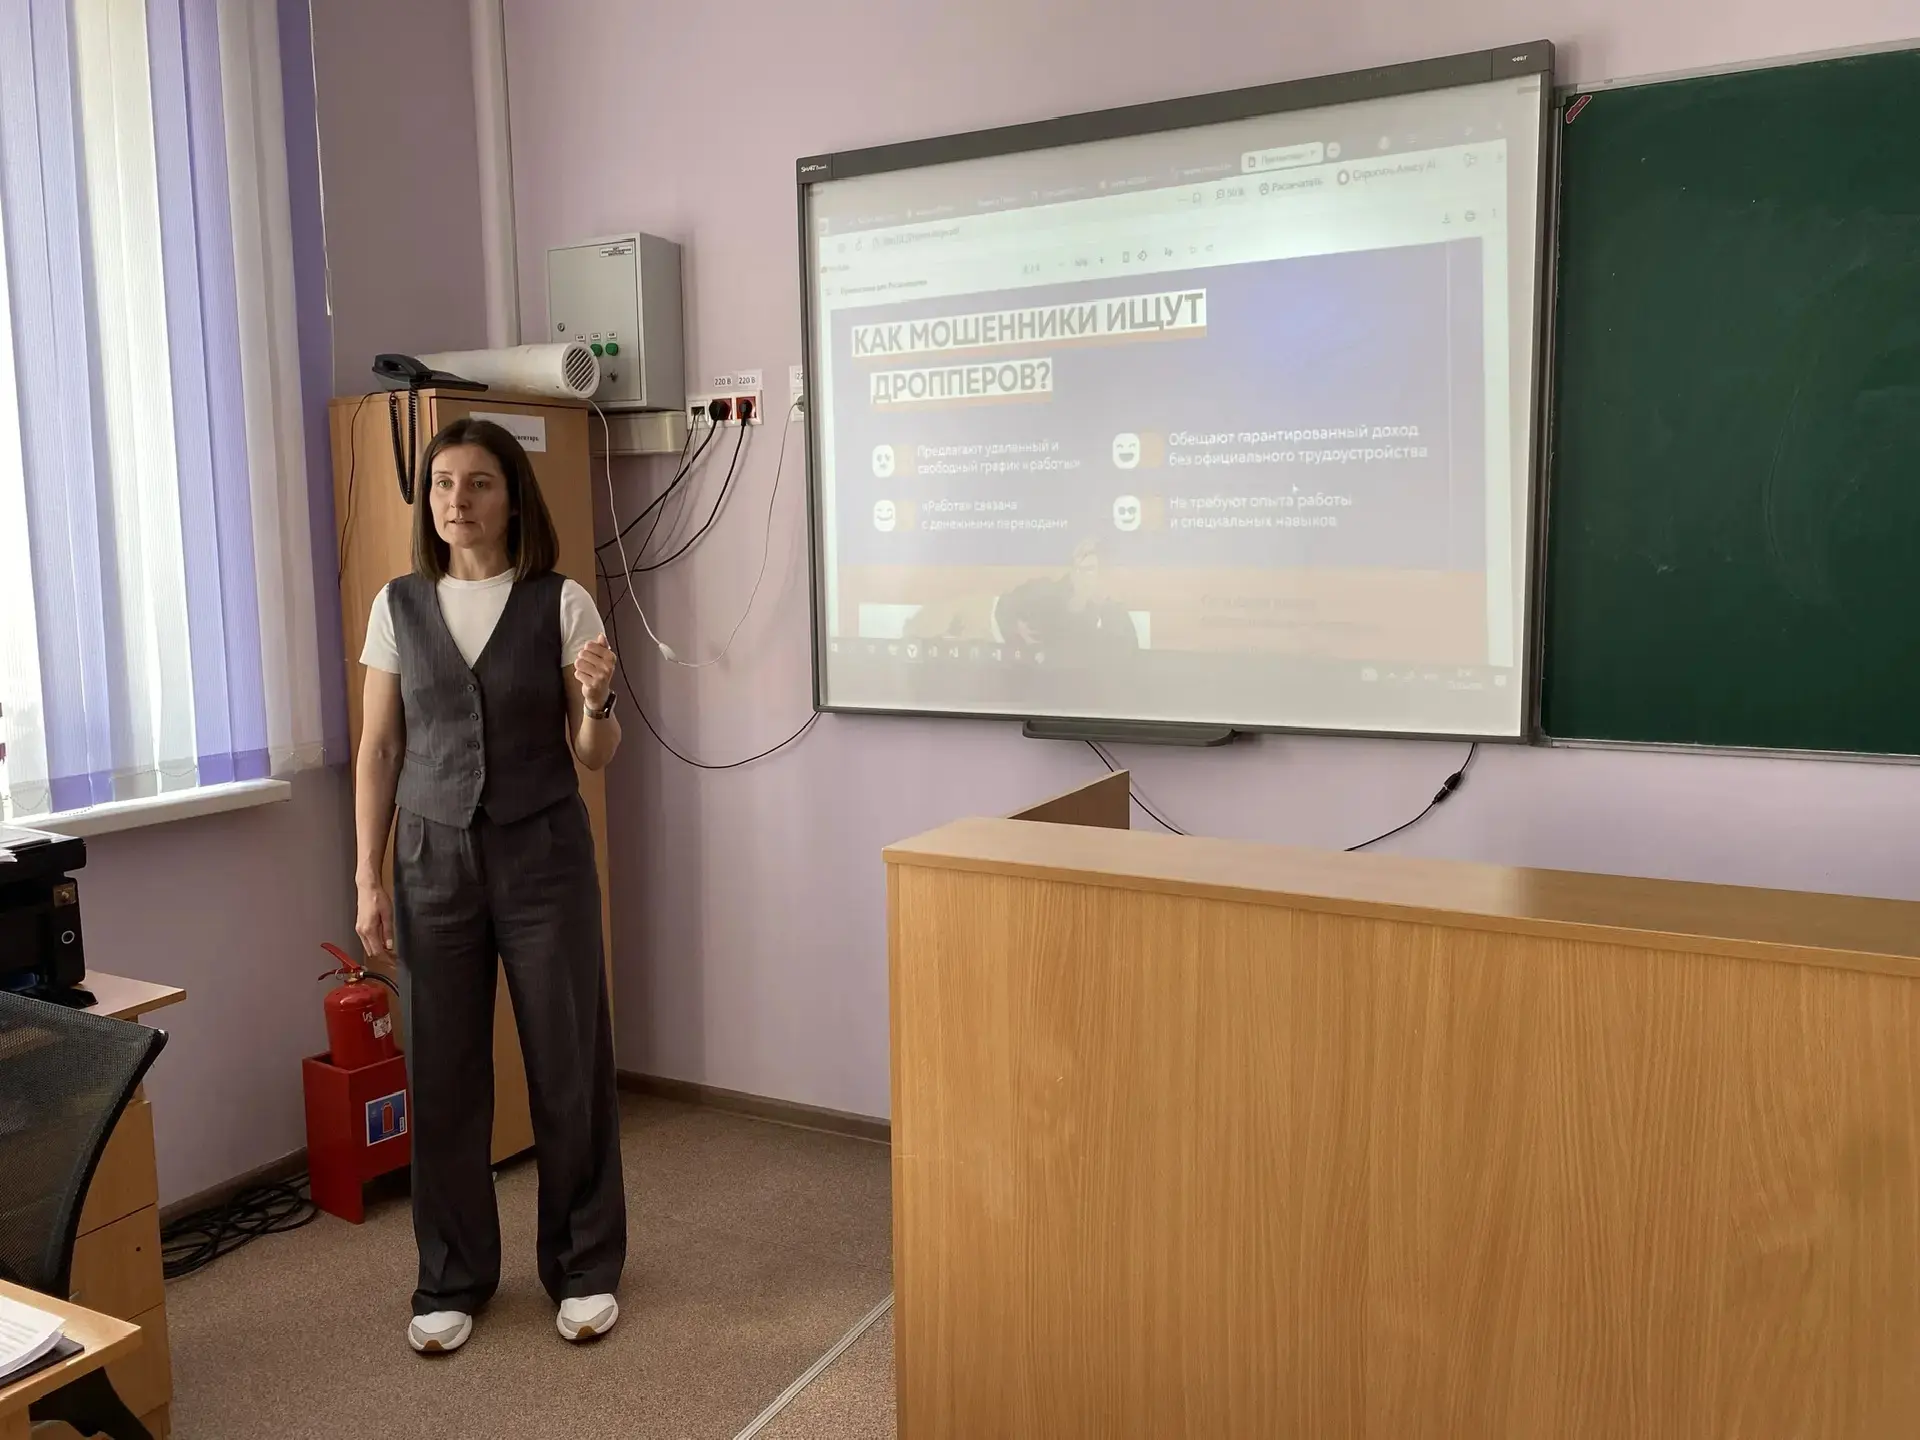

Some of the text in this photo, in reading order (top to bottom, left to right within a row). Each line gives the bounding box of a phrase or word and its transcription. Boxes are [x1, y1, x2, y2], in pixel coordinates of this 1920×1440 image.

[853, 292, 1204, 354] КАК МОШЕННИКИ ИЩУТ
[714, 378, 726, 386] 220
[738, 377, 751, 385] 220
[872, 360, 1051, 404] ДРОППЕРОВ?
[1168, 424, 1419, 447] Обещают гарантированный доход
[1194, 450, 1294, 467] официального
[1298, 445, 1429, 466] трудоустройства
[1297, 492, 1352, 511] работы
[1180, 515, 1273, 530] специальных
